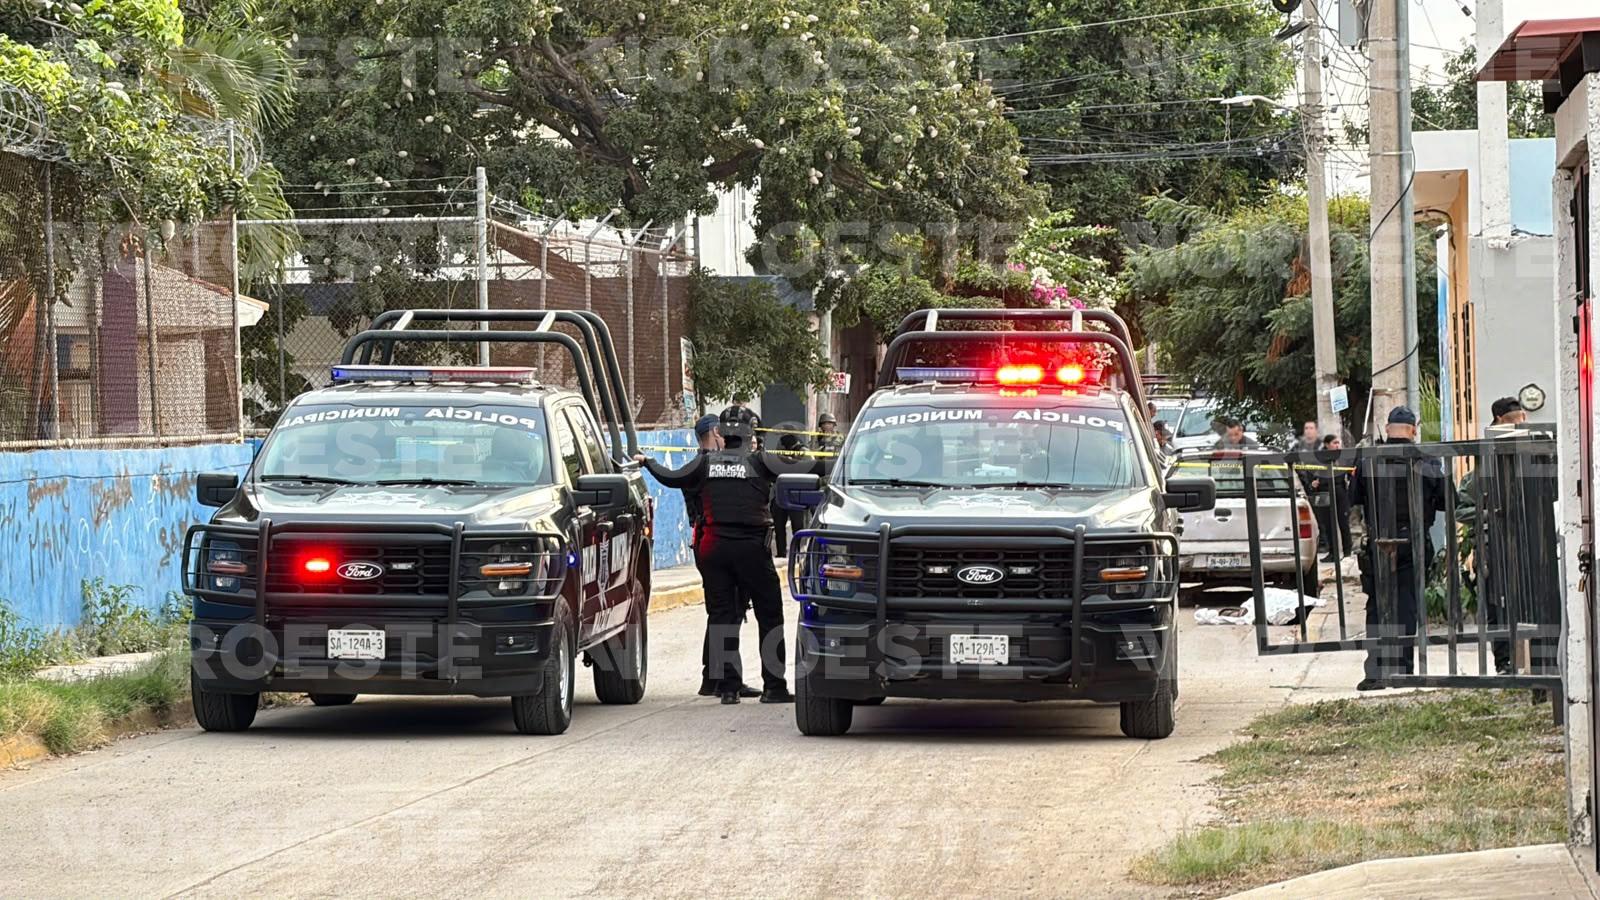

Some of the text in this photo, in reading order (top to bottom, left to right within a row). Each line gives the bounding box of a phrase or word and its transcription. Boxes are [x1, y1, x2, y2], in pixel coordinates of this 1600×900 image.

[708, 470, 746, 479] MUNICIPAL
[709, 463, 746, 473] POLICÍA
[344, 564, 374, 578] Ford
[965, 568, 995, 582] Ford
[329, 637, 384, 651] SA-124A-3
[952, 641, 1007, 656] SA-129A-3
